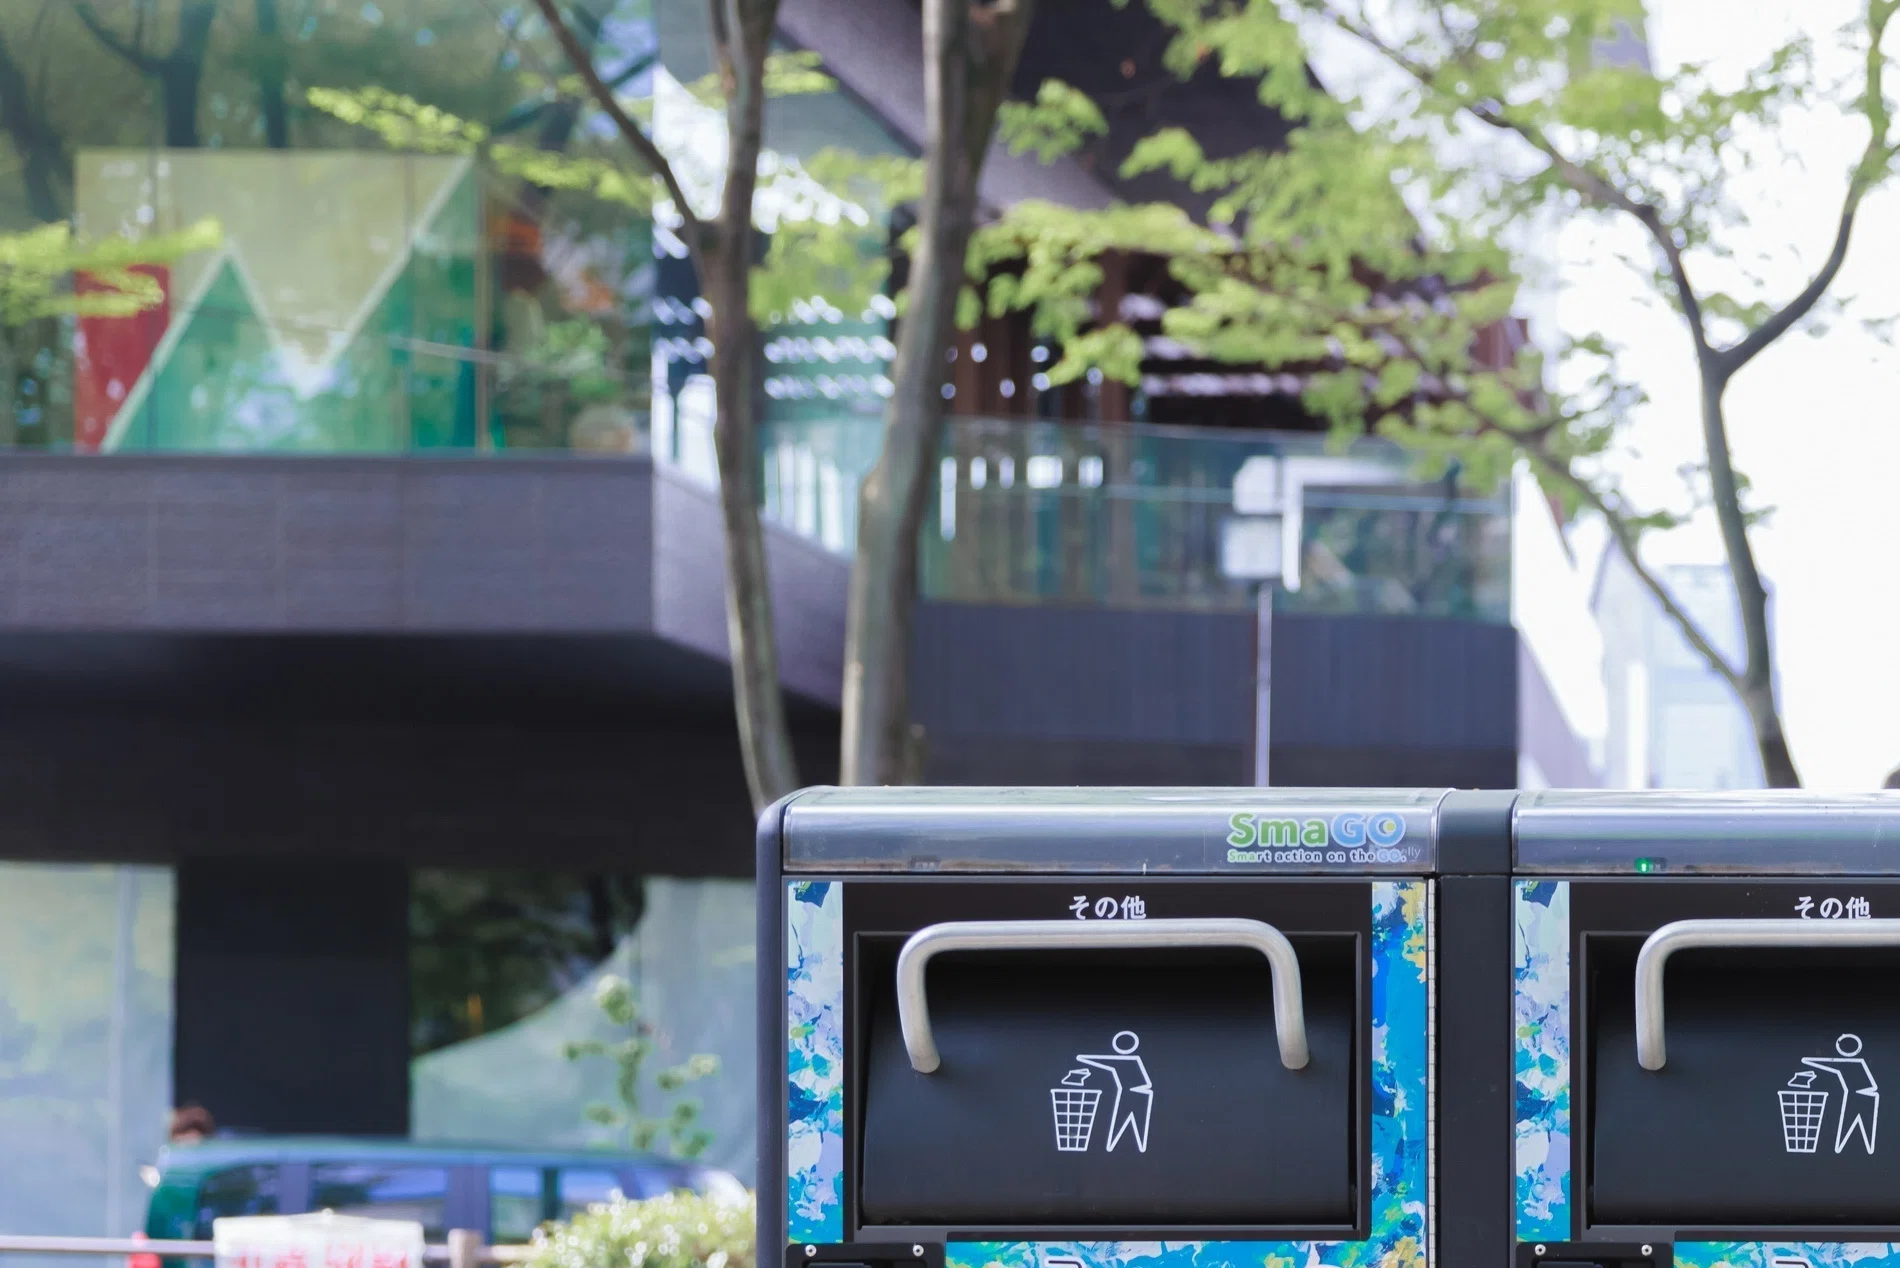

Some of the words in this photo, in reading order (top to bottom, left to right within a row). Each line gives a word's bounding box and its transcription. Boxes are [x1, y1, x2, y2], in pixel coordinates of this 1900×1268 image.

[1227, 812, 1407, 847] SmaGO
[1228, 848, 1272, 862] Smart
[1275, 848, 1322, 862] action
[1326, 849, 1346, 862] on
[1350, 848, 1374, 862] the
[1068, 895, 1147, 920] その他
[1794, 895, 1872, 919] その他
